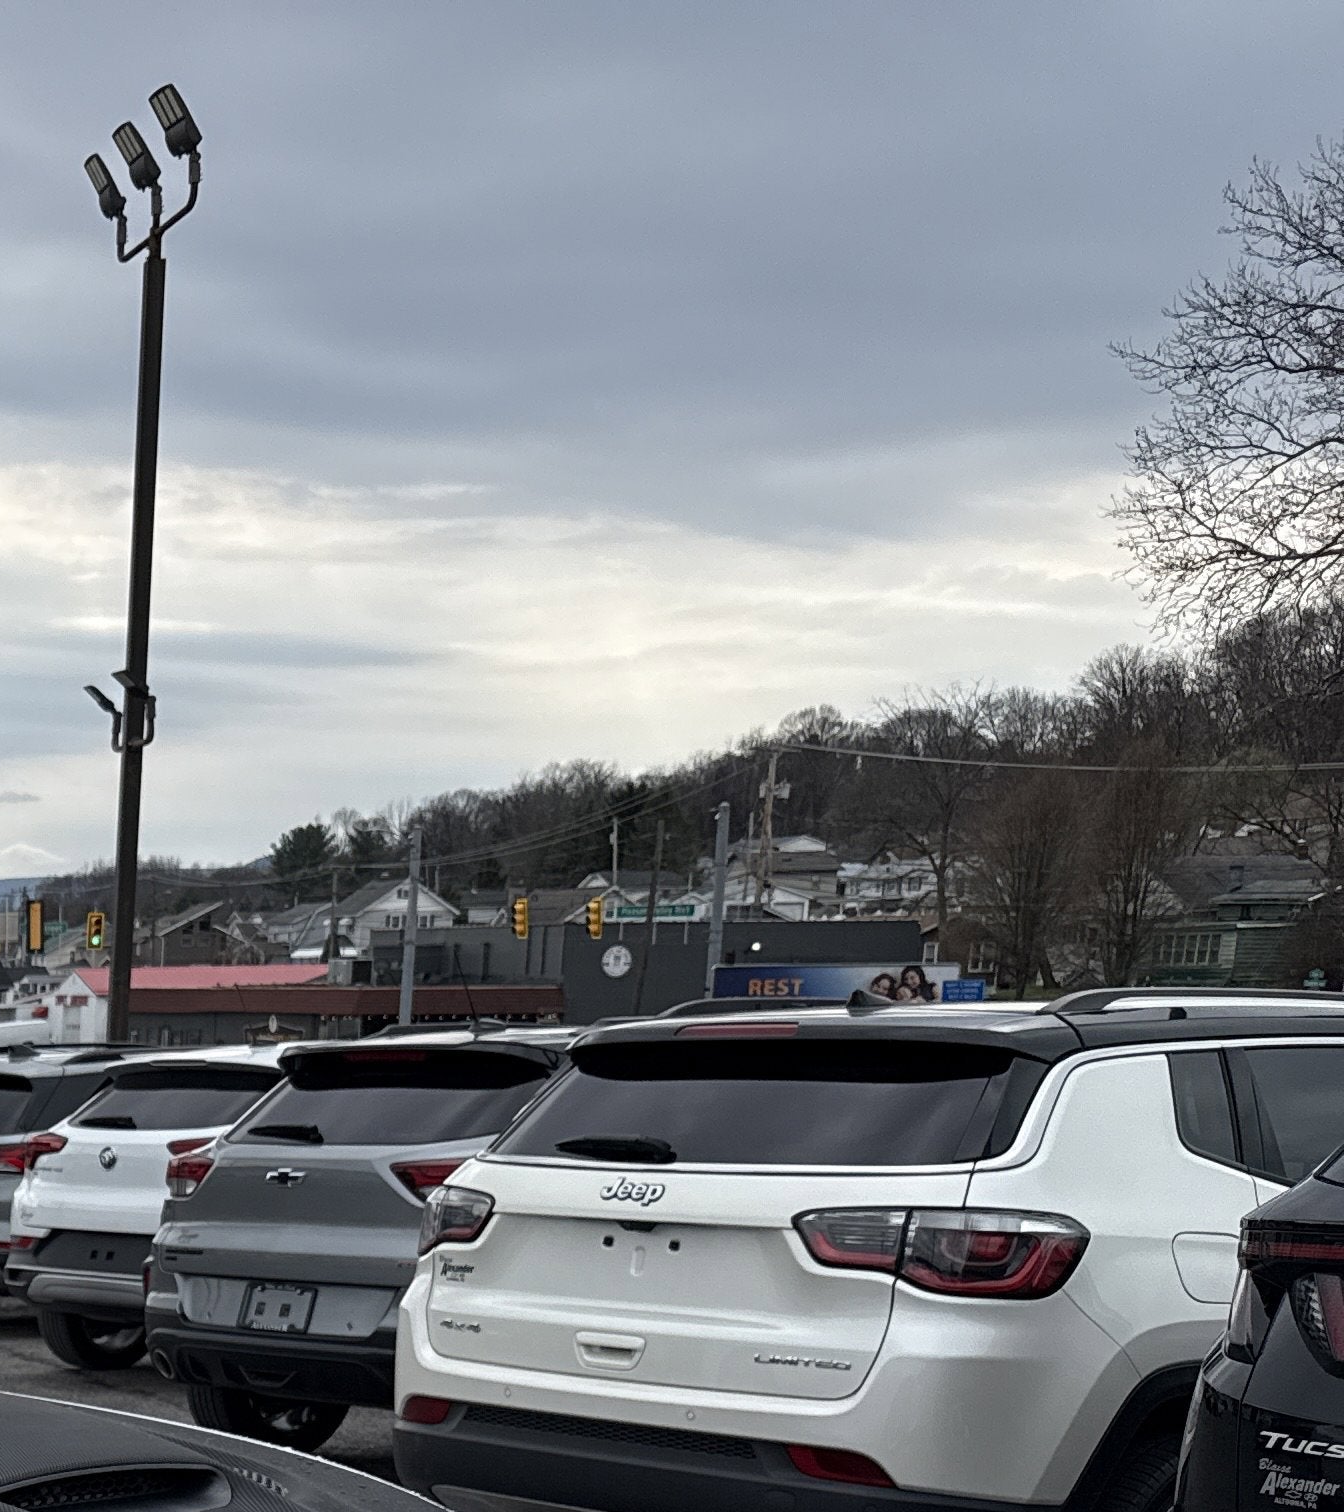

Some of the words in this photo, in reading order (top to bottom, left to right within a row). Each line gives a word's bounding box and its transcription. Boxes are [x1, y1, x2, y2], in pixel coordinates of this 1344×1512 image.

[748, 978, 804, 997] REST
[600, 1177, 665, 1206] Jeep
[753, 1353, 852, 1371] LIMITED
[1258, 1457, 1292, 1474] Blaise
[1259, 1471, 1341, 1496] Alexander
